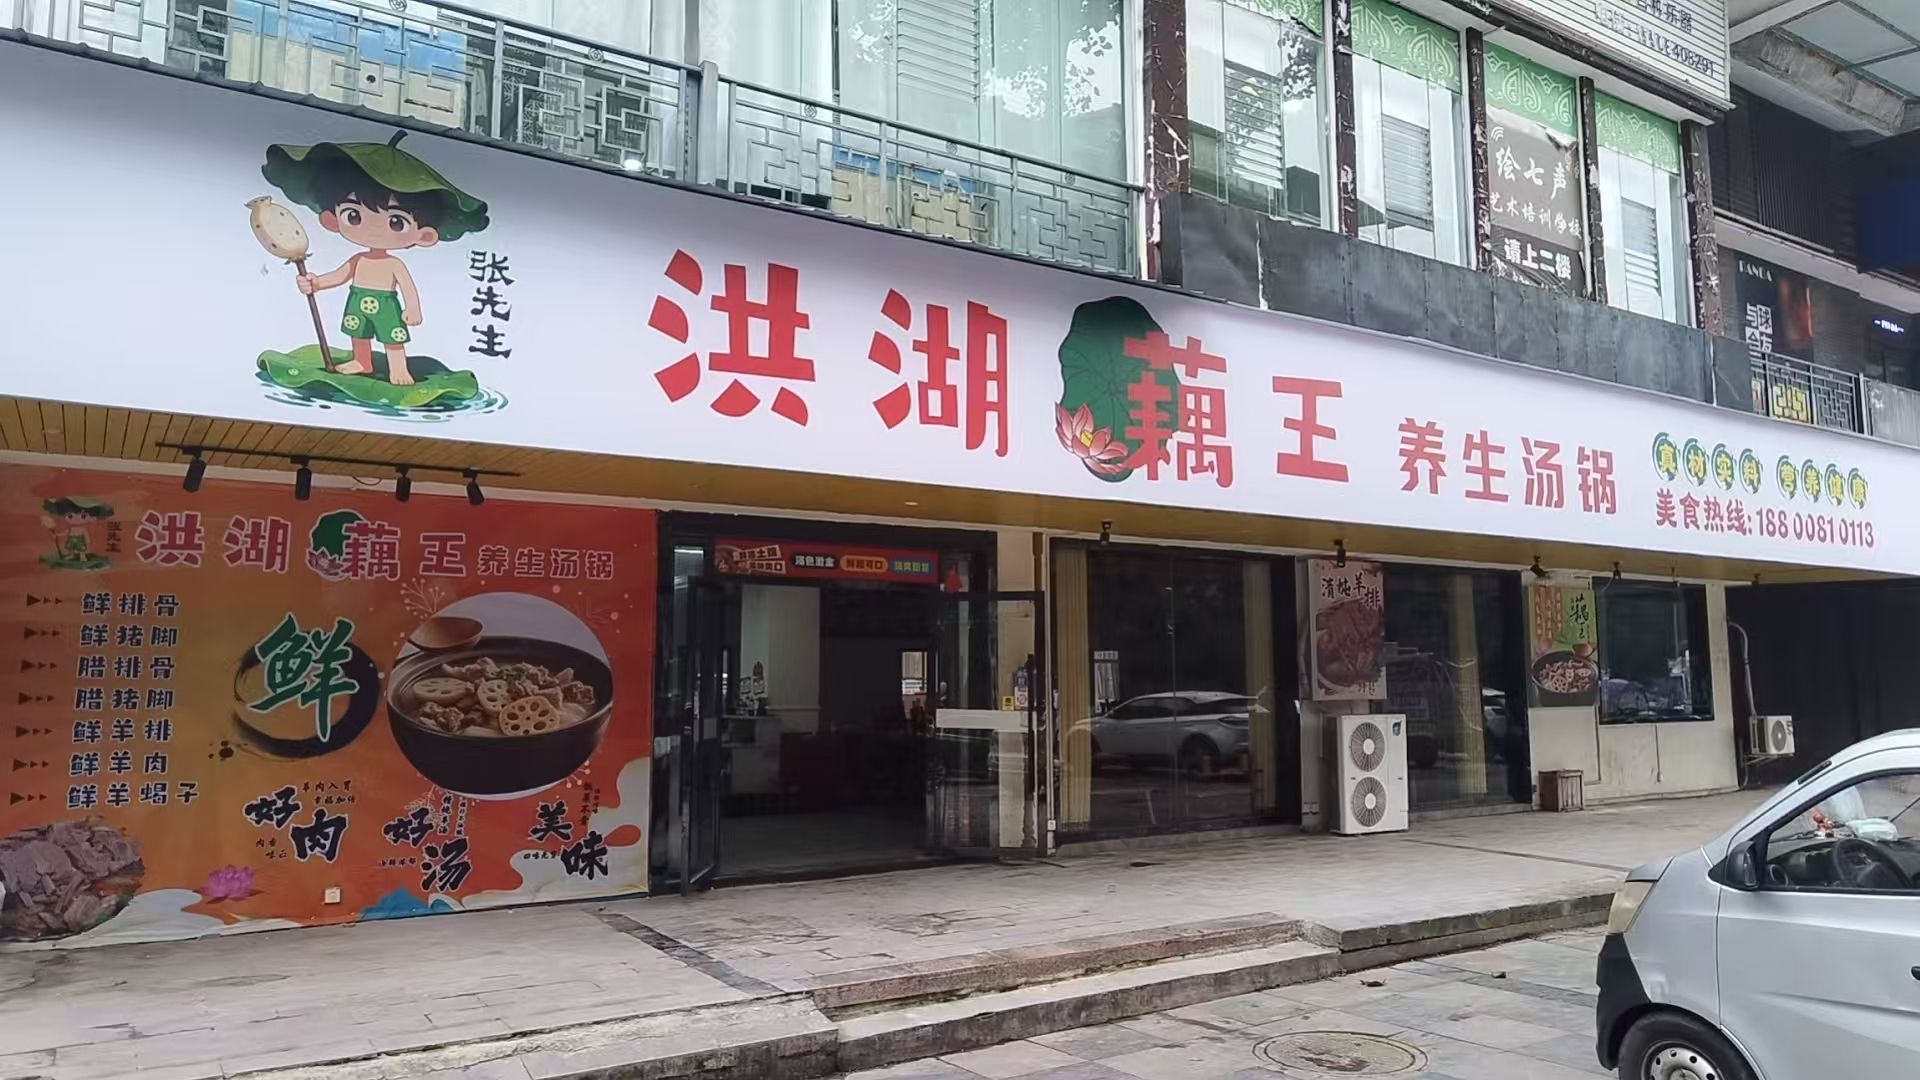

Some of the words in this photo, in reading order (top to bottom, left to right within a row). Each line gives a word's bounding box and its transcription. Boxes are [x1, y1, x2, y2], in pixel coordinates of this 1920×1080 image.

[1495, 145, 1567, 200] 绘七声
[1490, 191, 1582, 239] 艺术培训学校
[1504, 237, 1572, 280] 请上二楼
[468, 249, 515, 359] 张先生
[648, 248, 1349, 489] 洪湖藕王
[1398, 417, 1616, 515] 养生汤锅
[1656, 439, 1762, 491] 真材实料
[1778, 459, 1867, 507] 营养健康
[134, 510, 468, 580] 洪湖藕王
[477, 545, 614, 580] 养生汤锅
[82, 593, 179, 616] 鲜排骨
[1321, 571, 1381, 609] 清炖羊排
[80, 624, 178, 647] 鲜猪脚
[77, 655, 175, 679] 腊排骨
[248, 612, 360, 743] 鲜
[75, 687, 173, 710] 腊猪脚
[73, 719, 171, 742] 鲜羊排
[69, 751, 167, 775] 鲜羊肉
[67, 782, 198, 808] 鲜羊蝎子
[244, 786, 348, 862] 好肉
[529, 800, 609, 881] 美味
[382, 806, 472, 893] 好汤
